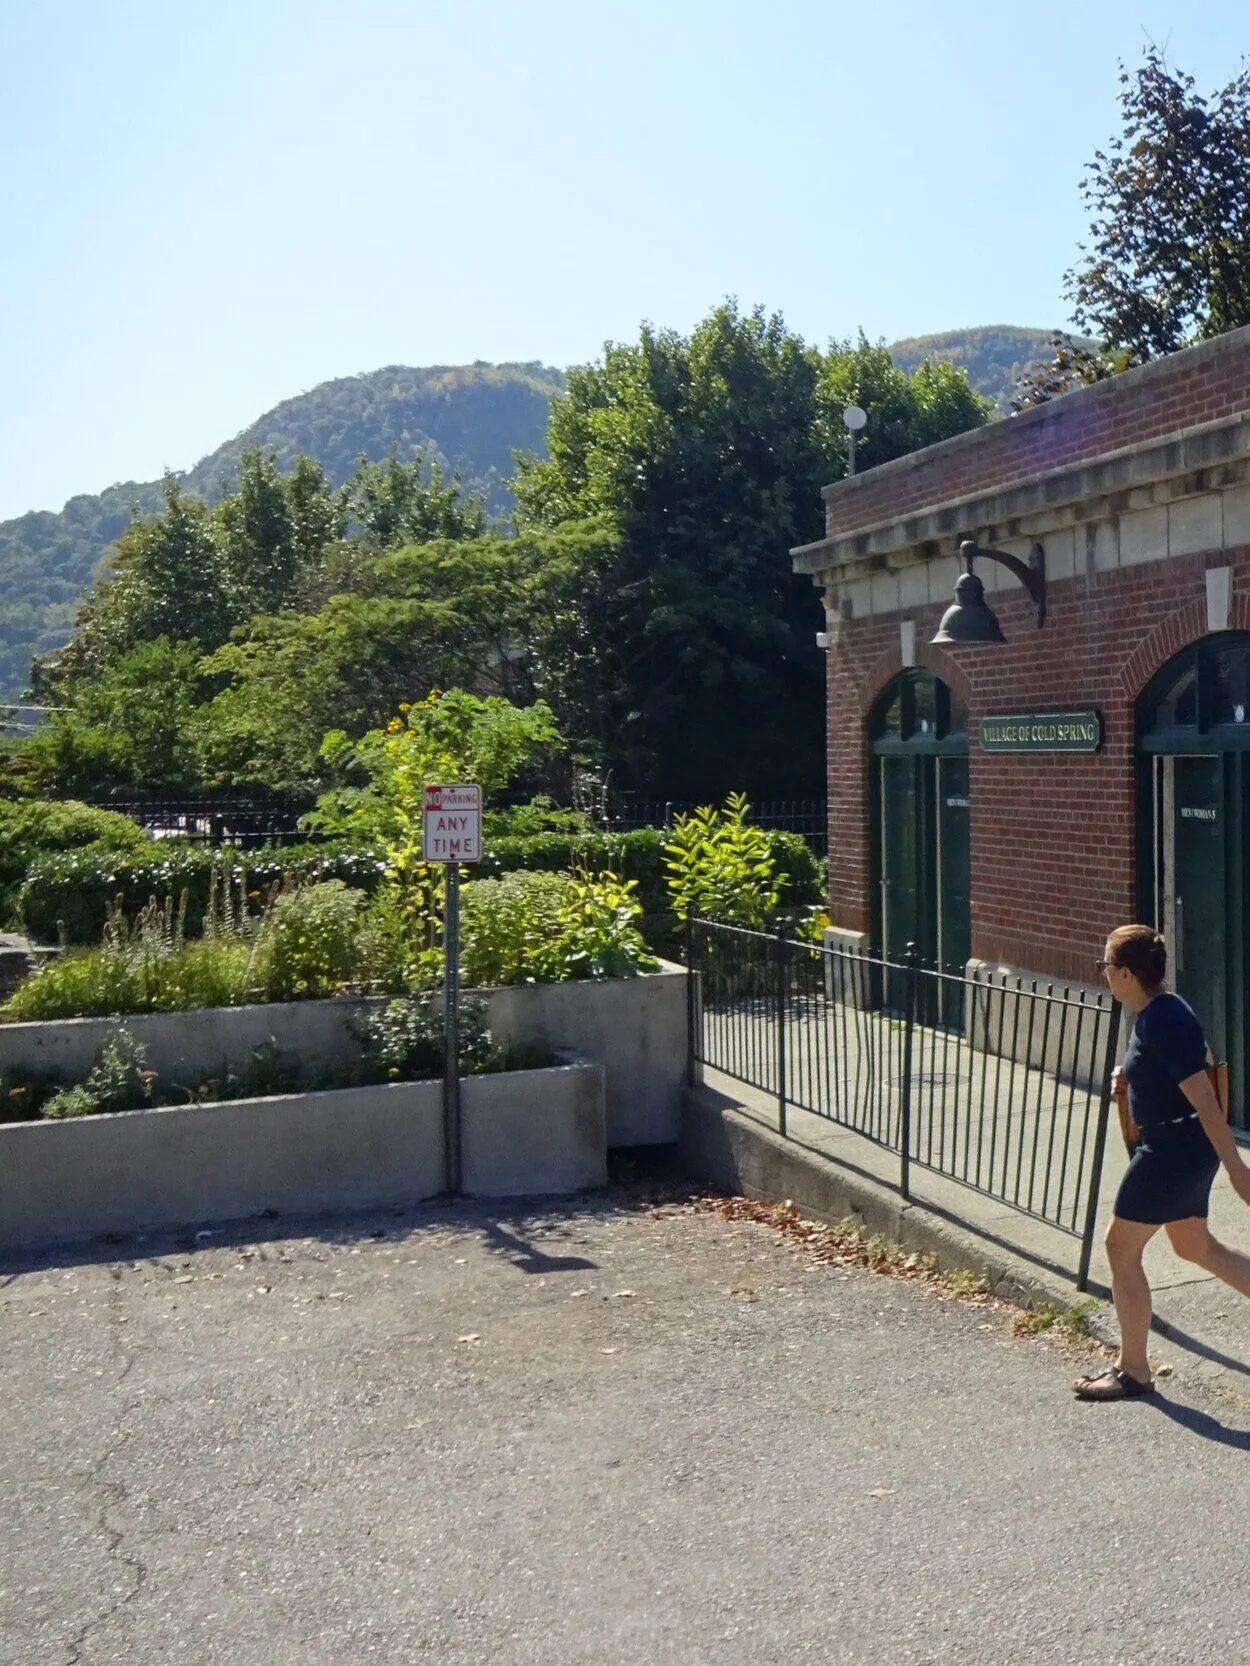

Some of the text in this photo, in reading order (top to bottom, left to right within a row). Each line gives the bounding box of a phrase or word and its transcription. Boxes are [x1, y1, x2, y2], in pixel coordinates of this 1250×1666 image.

[983, 722, 1095, 742] VILLAGE OF COLD SPRING
[427, 791, 477, 805] NO PARKING
[436, 816, 469, 832] ANY
[433, 838, 473, 853] TIME
